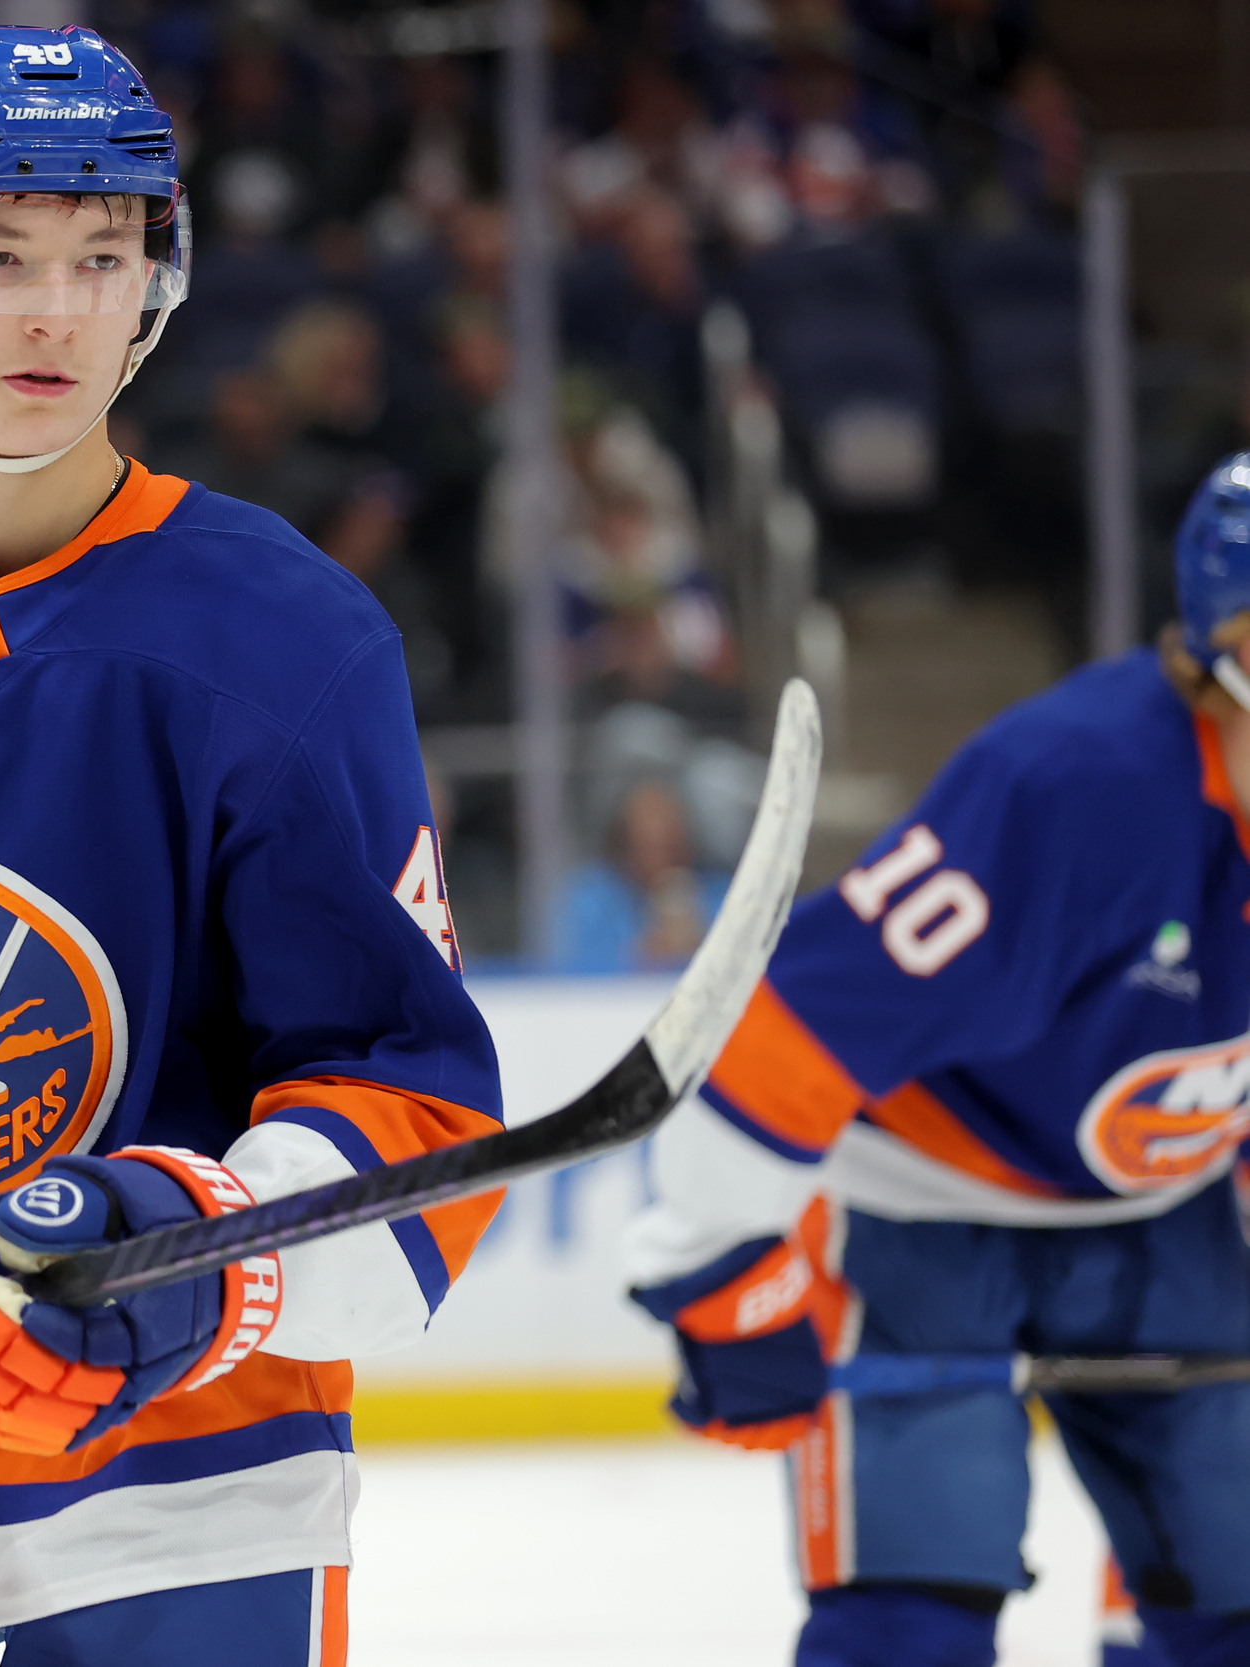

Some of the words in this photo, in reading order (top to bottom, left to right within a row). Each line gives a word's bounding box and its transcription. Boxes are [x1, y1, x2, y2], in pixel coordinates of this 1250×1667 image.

[5, 106, 106, 120] WARRIOR
[391, 825, 463, 975] 4
[838, 822, 990, 979] 10
